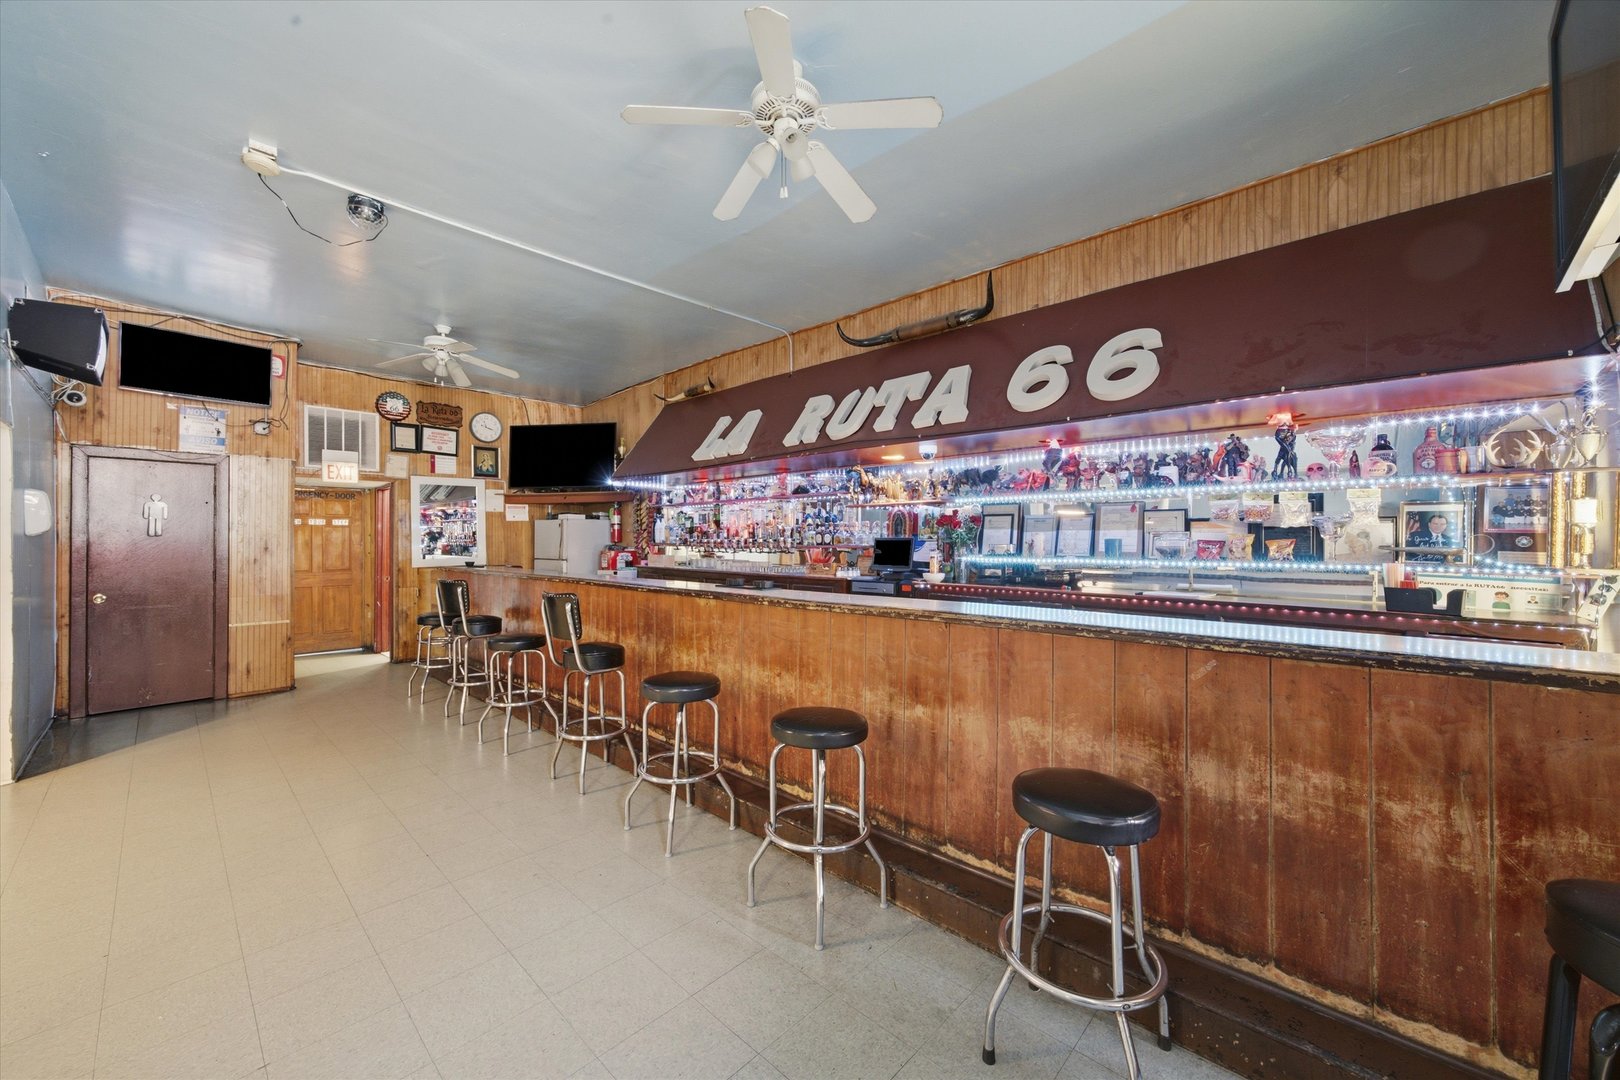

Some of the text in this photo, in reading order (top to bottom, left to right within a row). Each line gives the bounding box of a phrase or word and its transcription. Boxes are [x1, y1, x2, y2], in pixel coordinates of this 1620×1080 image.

[691, 327, 1164, 461] LA RUTA 66
[327, 464, 354, 481] EXIT
